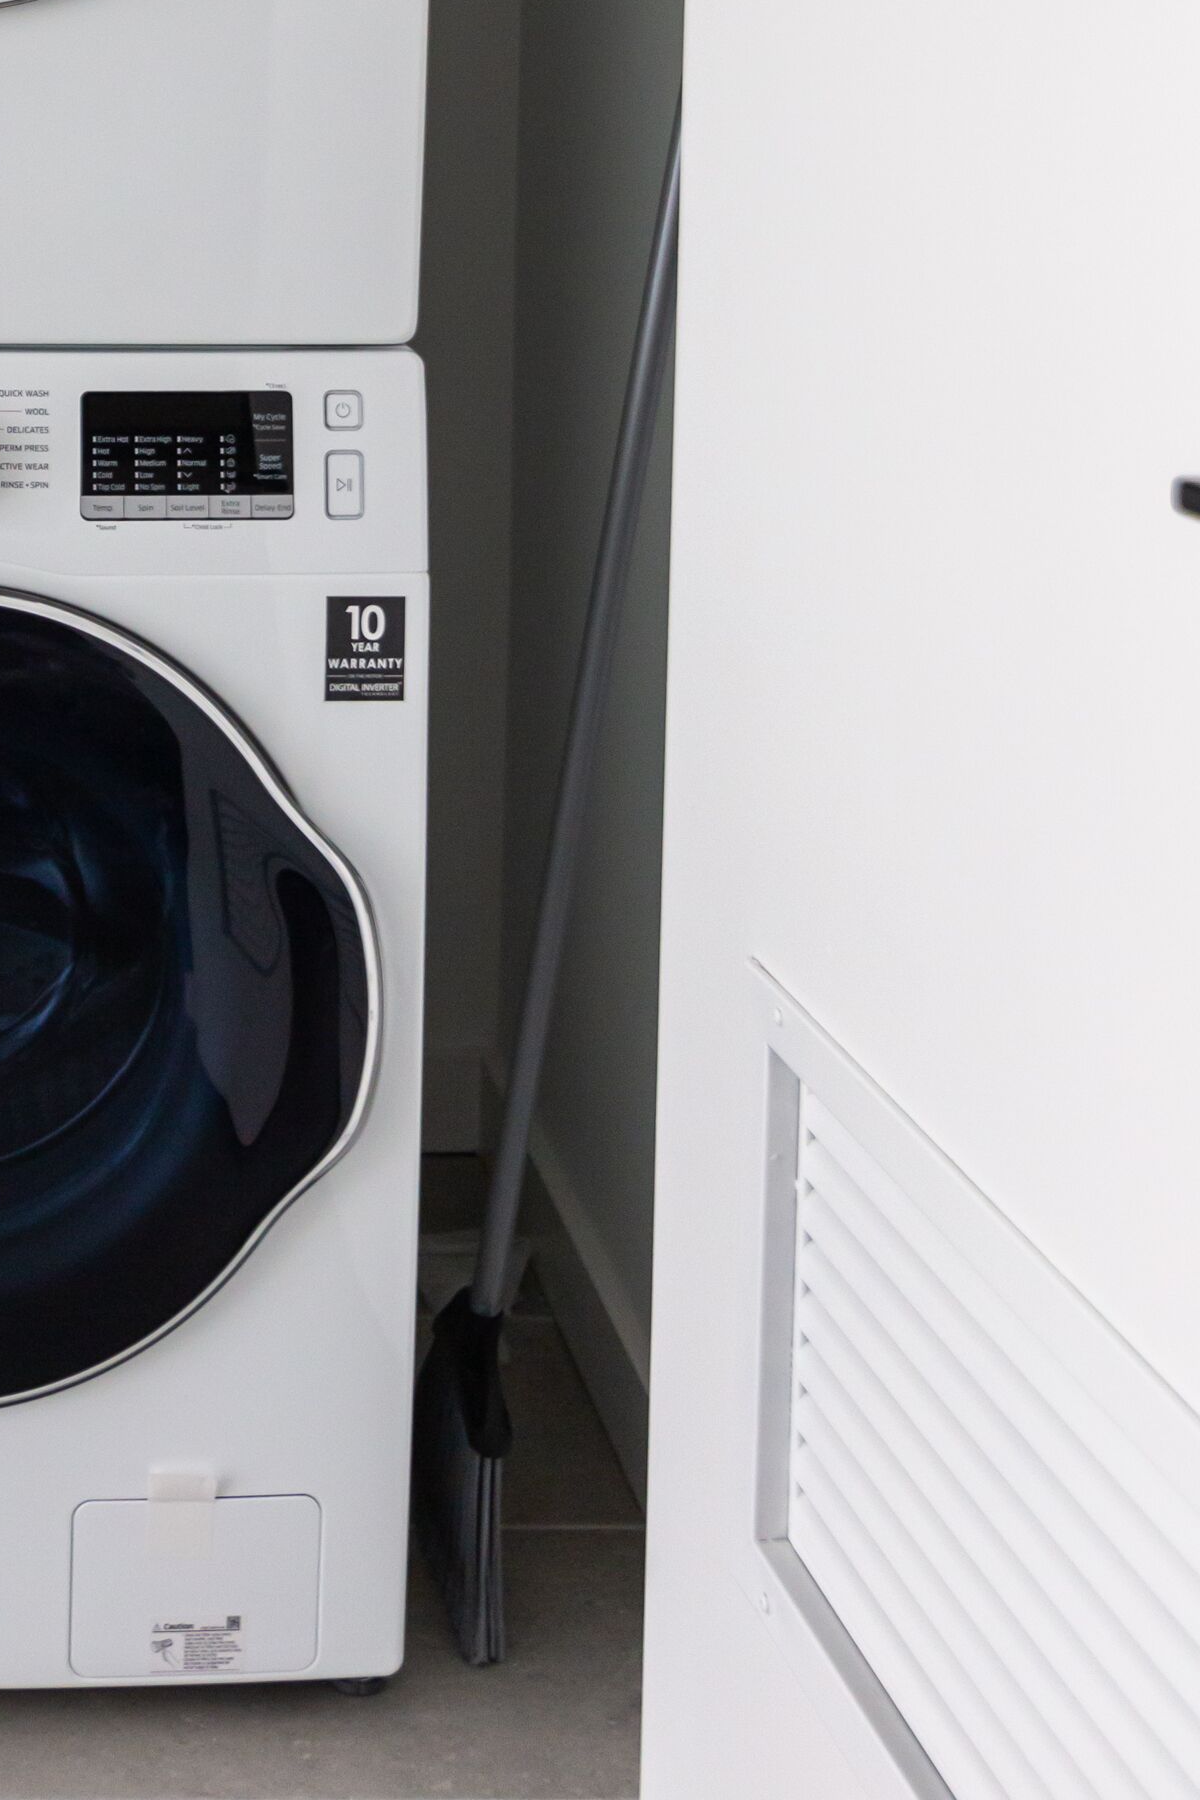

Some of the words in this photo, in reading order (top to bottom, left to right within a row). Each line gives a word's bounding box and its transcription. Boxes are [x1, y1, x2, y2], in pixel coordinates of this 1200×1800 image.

[24, 389, 49, 397] WASH
[25, 407, 49, 416] WOOL
[266, 414, 286, 422] Cycle
[7, 426, 49, 434] DELICATES
[0, 444, 22, 452] PERM
[24, 444, 49, 452] PRESS
[139, 448, 155, 456] High
[259, 454, 281, 462] Super
[25, 463, 49, 471] WEAR
[259, 462, 282, 470] Speed
[181, 484, 200, 492] Light
[137, 504, 153, 512] Spin
[345, 604, 386, 641] 10
[351, 642, 380, 652] YEAR
[328, 658, 402, 669] WARRANTY
[329, 683, 360, 692] DIGITAL
